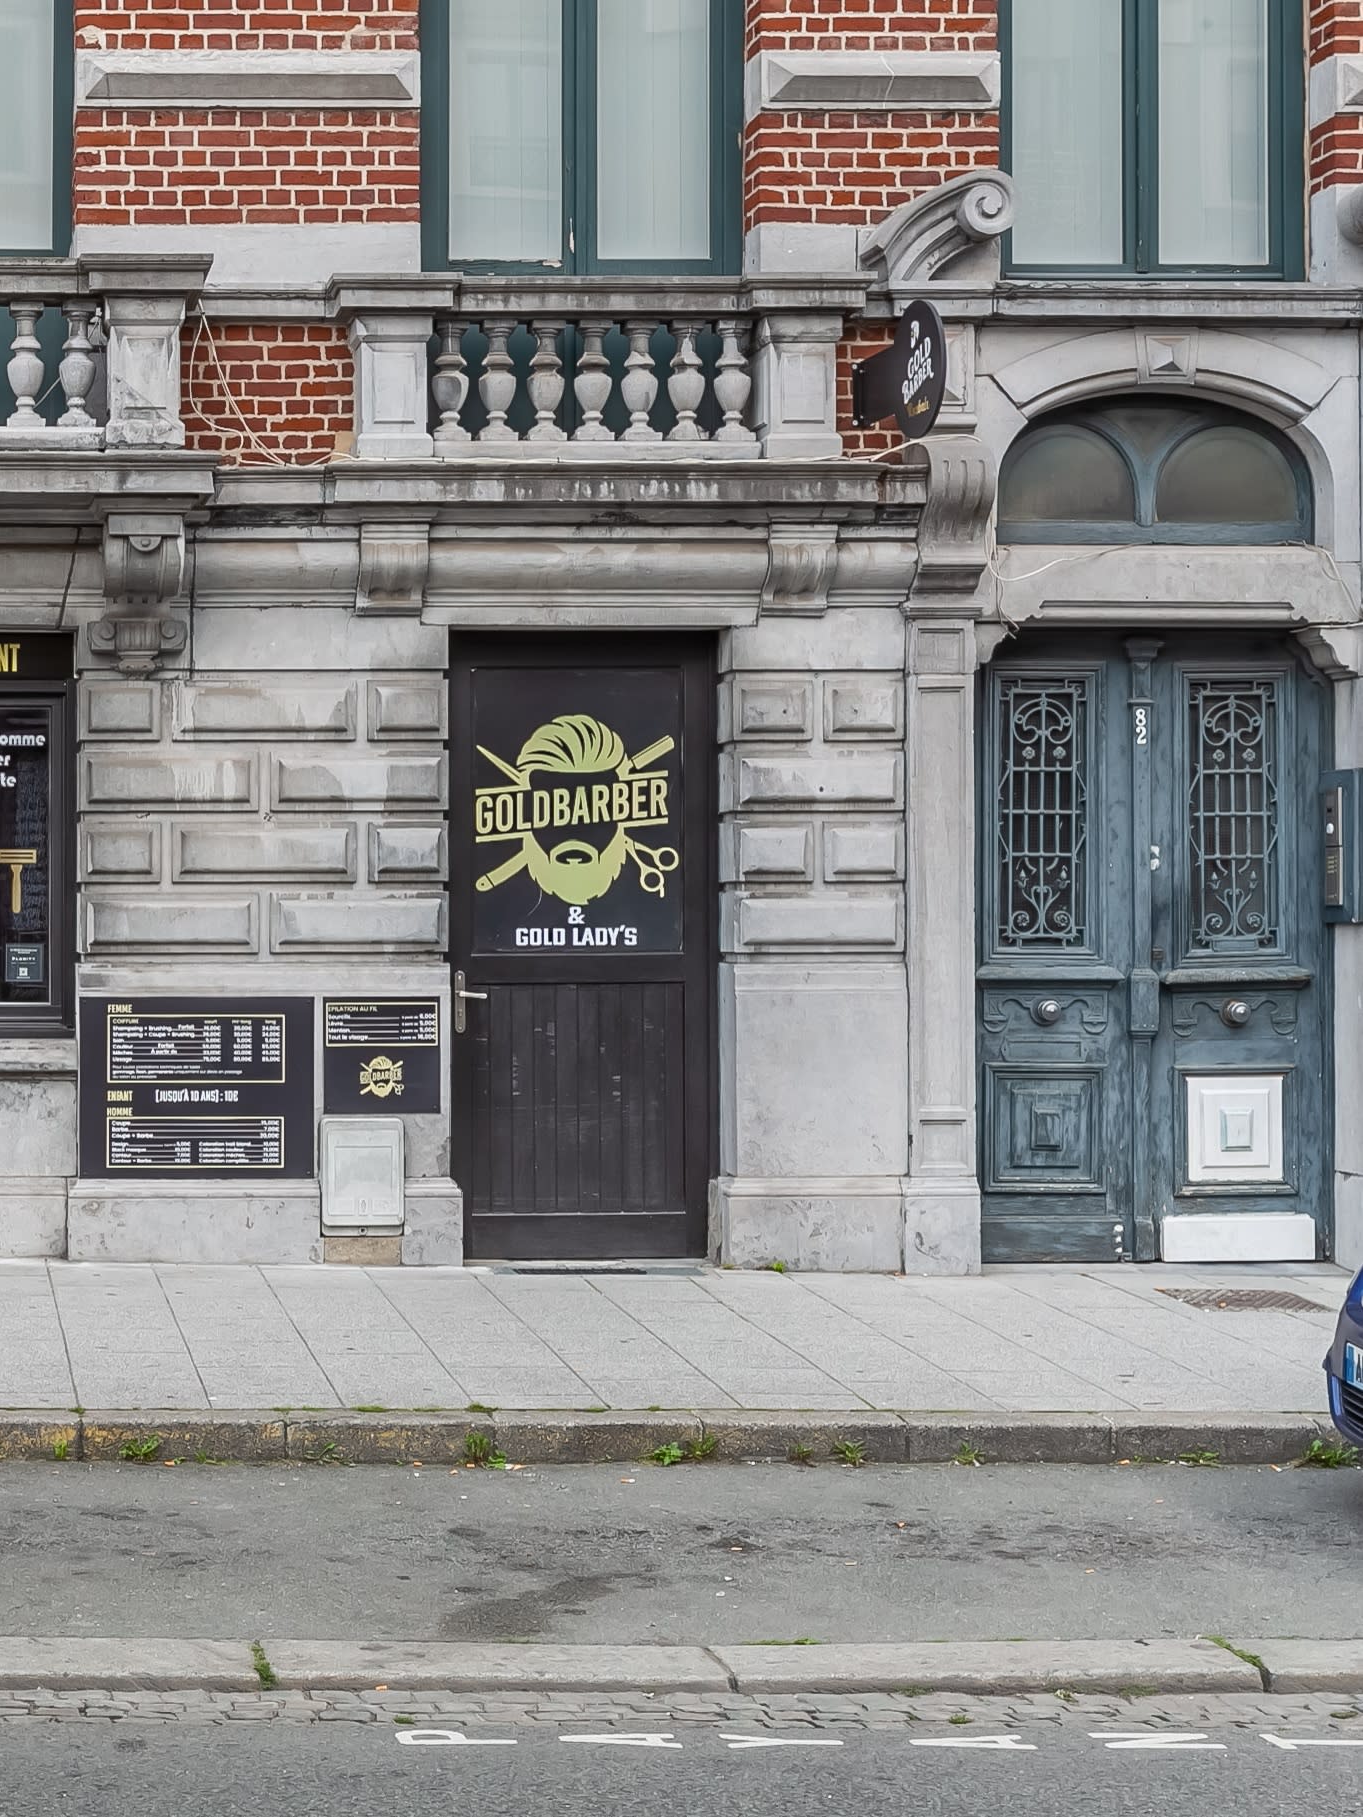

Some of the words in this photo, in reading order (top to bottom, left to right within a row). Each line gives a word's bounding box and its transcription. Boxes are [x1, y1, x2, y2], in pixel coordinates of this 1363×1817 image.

[907, 337, 931, 378] GOLD
[901, 358, 935, 405] BARBER
[1135, 708, 1147, 745] 82
[475, 778, 669, 834] GOLDBARBER
[567, 906, 586, 924] &
[515, 927, 566, 946] GOLD
[572, 924, 638, 946] LADY'S
[107, 1004, 133, 1013] FEMME
[107, 1090, 133, 1102] ENFANT
[190, 1090, 200, 1102] 10
[224, 1090, 239, 1102] 10€
[106, 1107, 133, 1117] HOMME
[394, 1729, 1363, 1750] PAYANT
